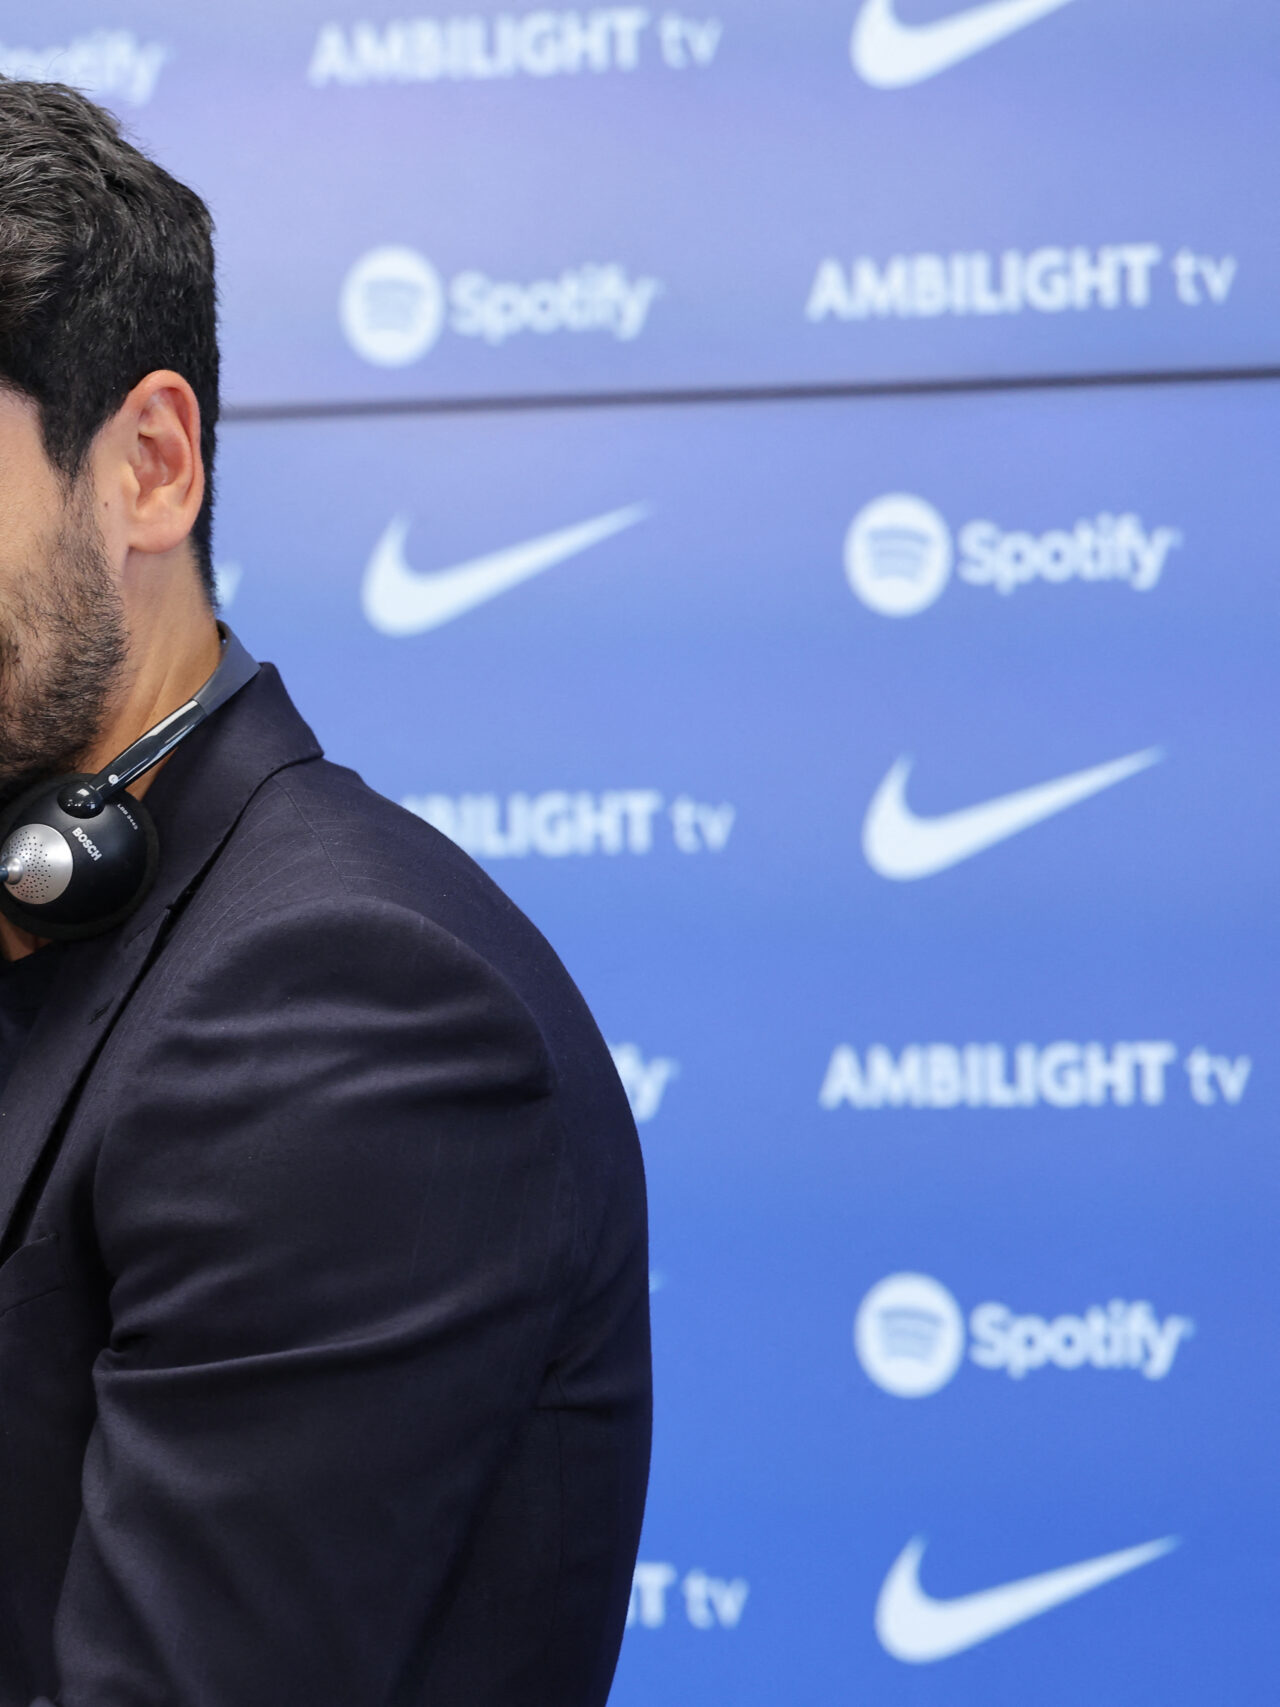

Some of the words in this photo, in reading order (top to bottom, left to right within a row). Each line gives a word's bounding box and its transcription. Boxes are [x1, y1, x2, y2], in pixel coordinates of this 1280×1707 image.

[309, 9, 645, 85] AMBILIGHT
[657, 11, 721, 69] tv
[449, 263, 658, 342] Spotify
[806, 245, 1160, 320] AMBILIGHT
[1170, 247, 1237, 305] tv
[957, 513, 1179, 593] Spotify
[72, 826, 103, 861] BOSCH
[670, 795, 735, 853] tv
[820, 1042, 1175, 1108] AMBILIGHT
[1185, 1047, 1251, 1105] tv
[969, 1299, 1193, 1380] Spotify
[682, 1570, 748, 1629] tv
